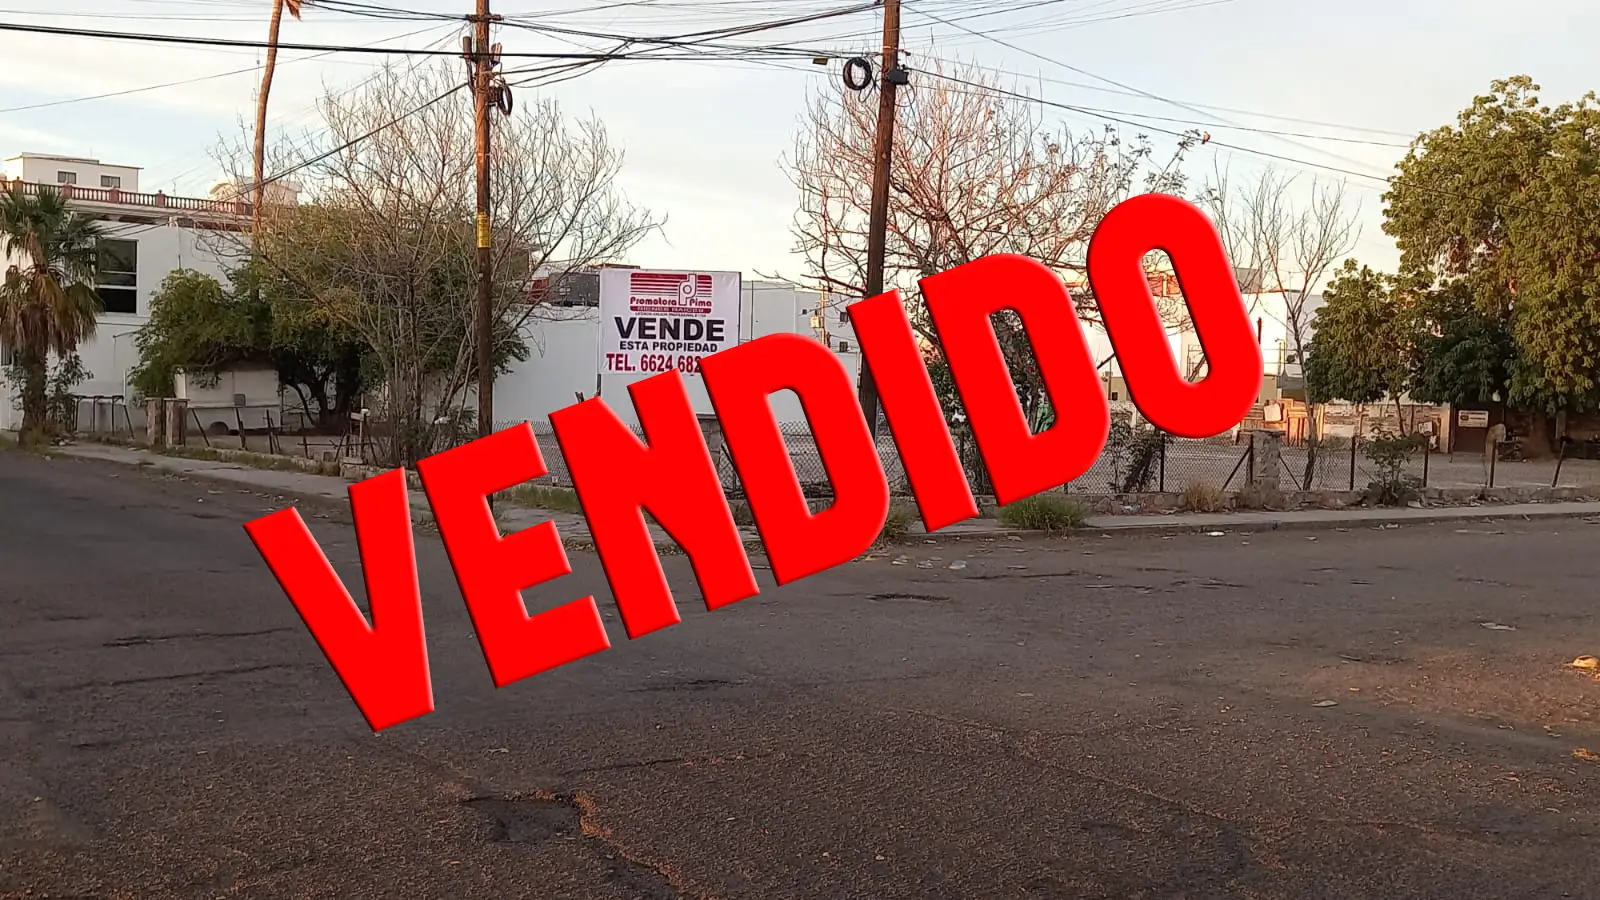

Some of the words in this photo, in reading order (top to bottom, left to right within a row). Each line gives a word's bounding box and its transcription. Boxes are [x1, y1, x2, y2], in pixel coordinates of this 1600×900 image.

[630, 296, 677, 306] Promotora
[689, 298, 713, 307] Pima
[614, 316, 725, 341] VENDE
[619, 341, 649, 351] ESTA
[652, 342, 718, 353] PROPIEDAD
[606, 353, 636, 371] TEL.
[640, 354, 674, 372] 6624
